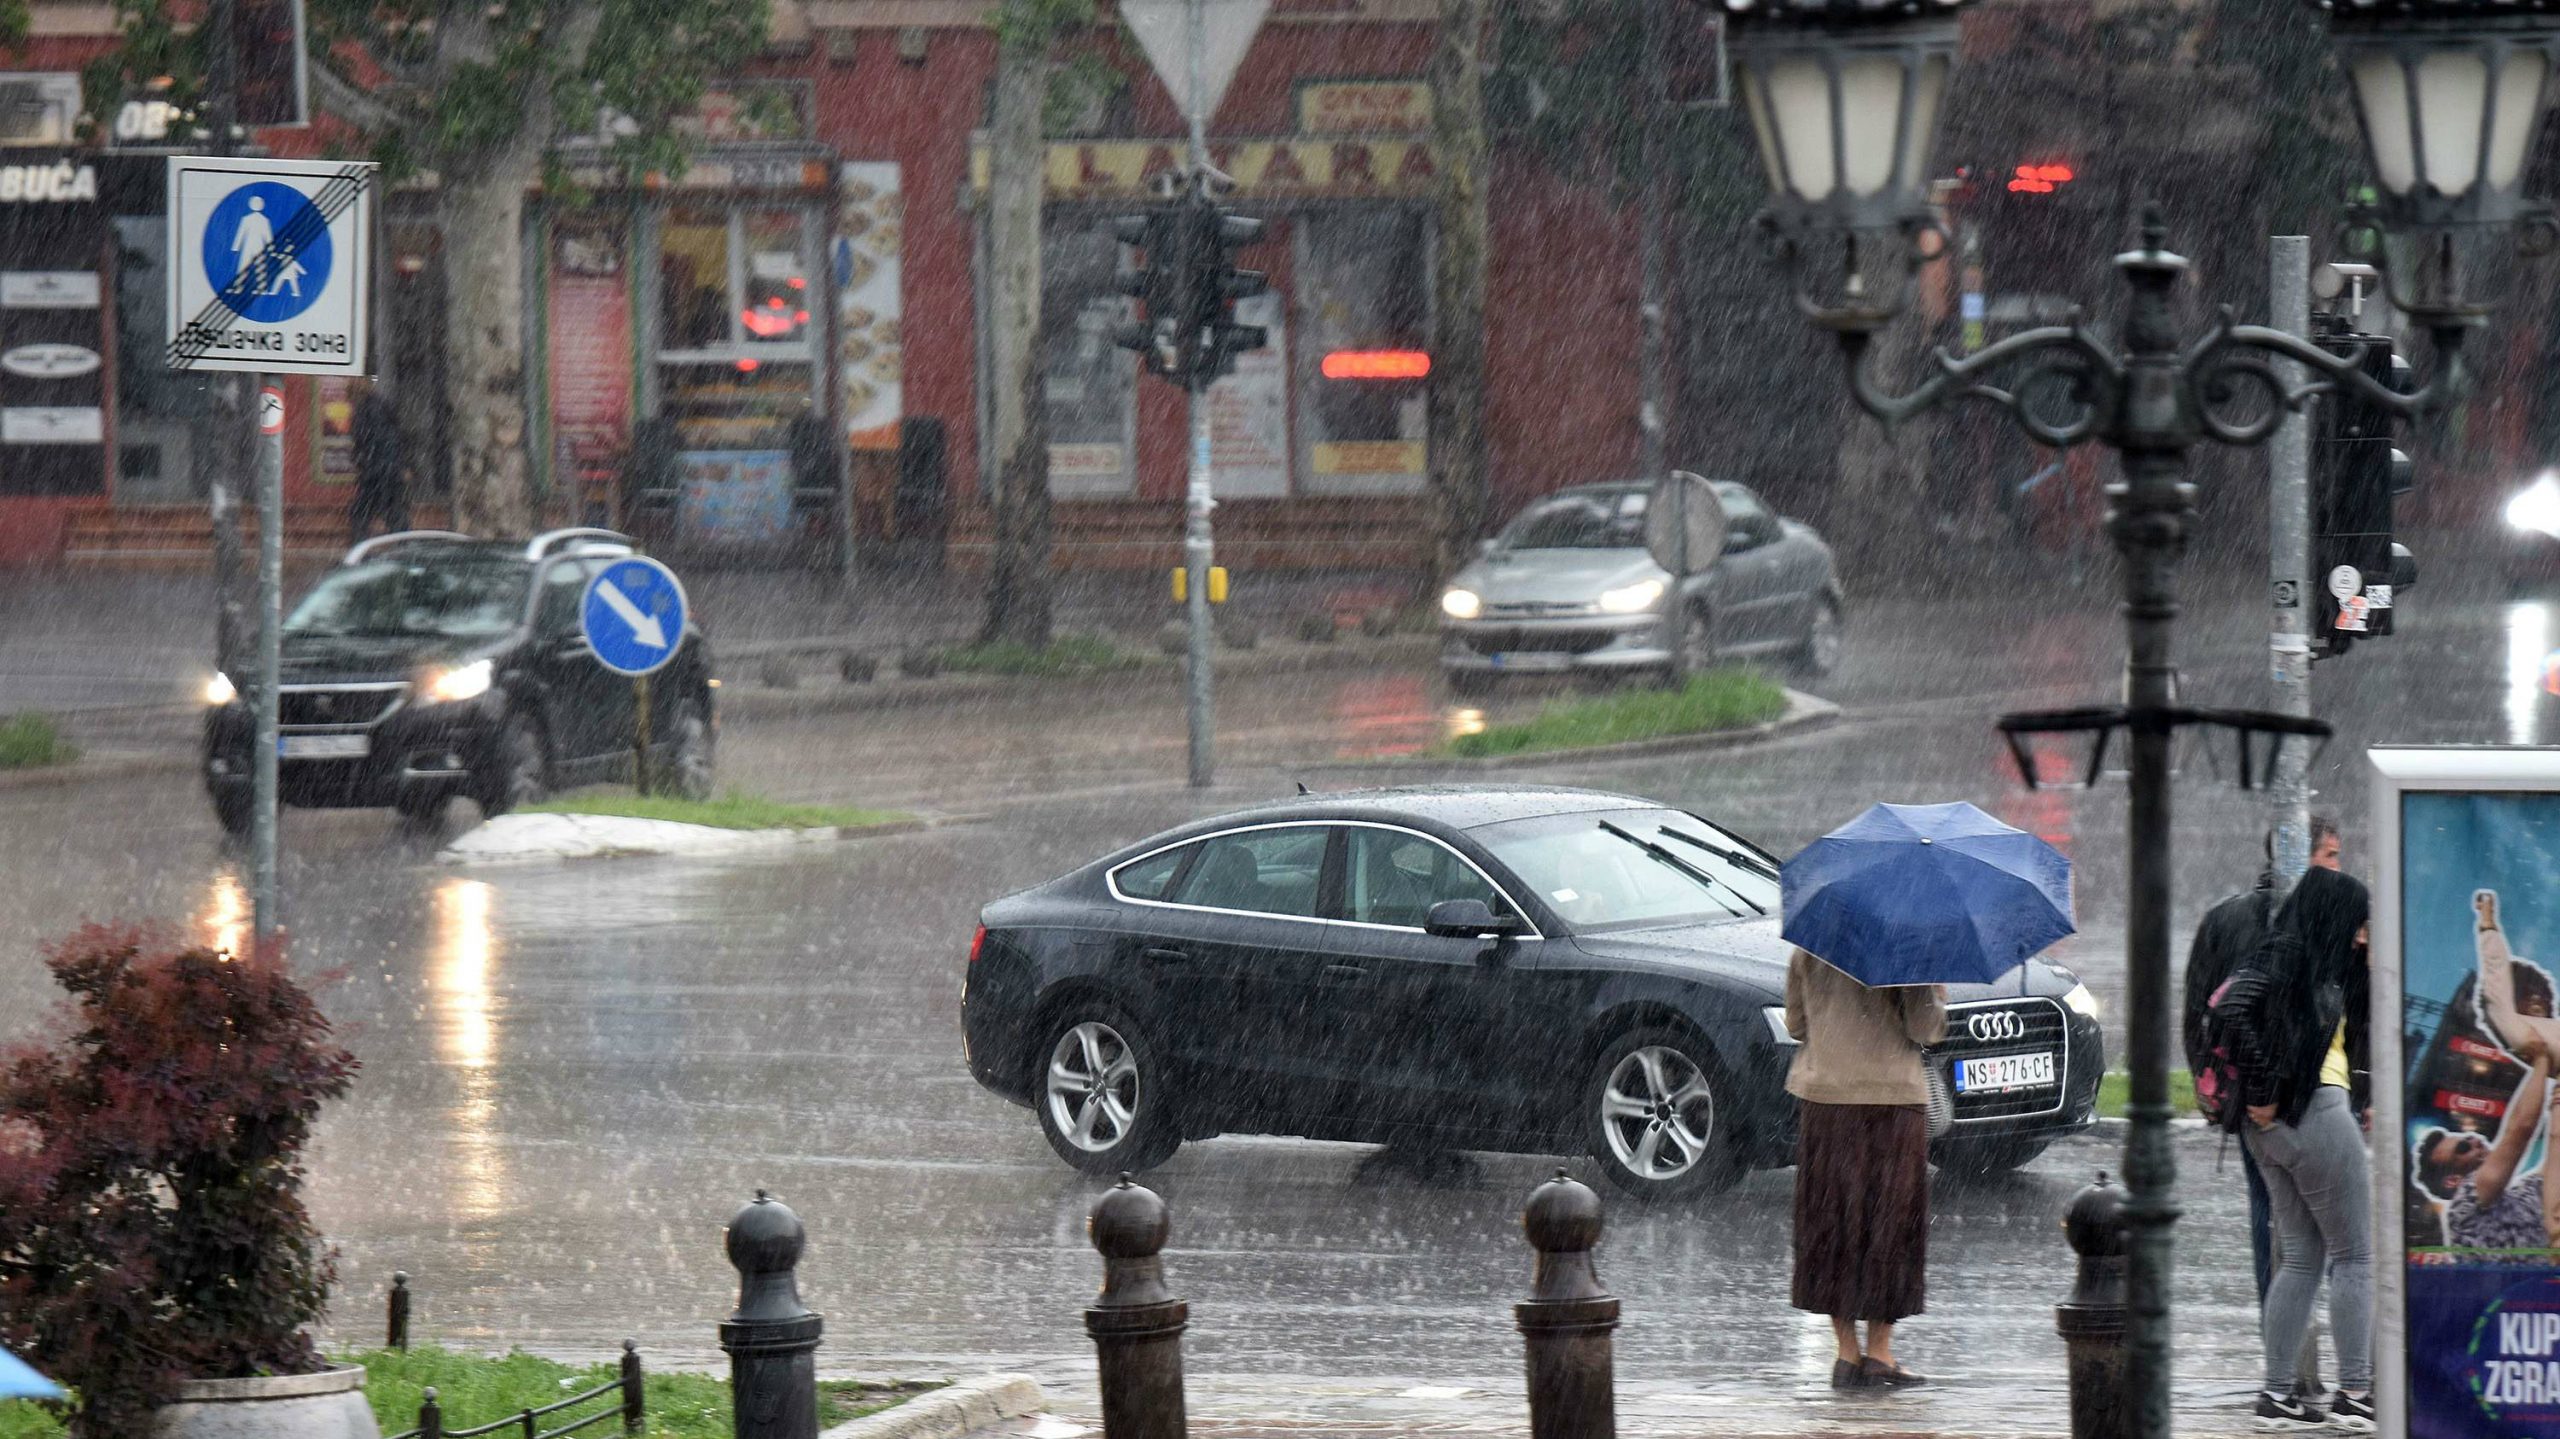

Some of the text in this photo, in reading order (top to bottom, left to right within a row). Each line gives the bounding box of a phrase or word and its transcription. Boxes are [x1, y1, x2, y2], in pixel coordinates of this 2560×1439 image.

[294, 332, 346, 354] зона
[1967, 1063, 1988, 1086] NS
[2500, 1312, 2560, 1356] KUP
